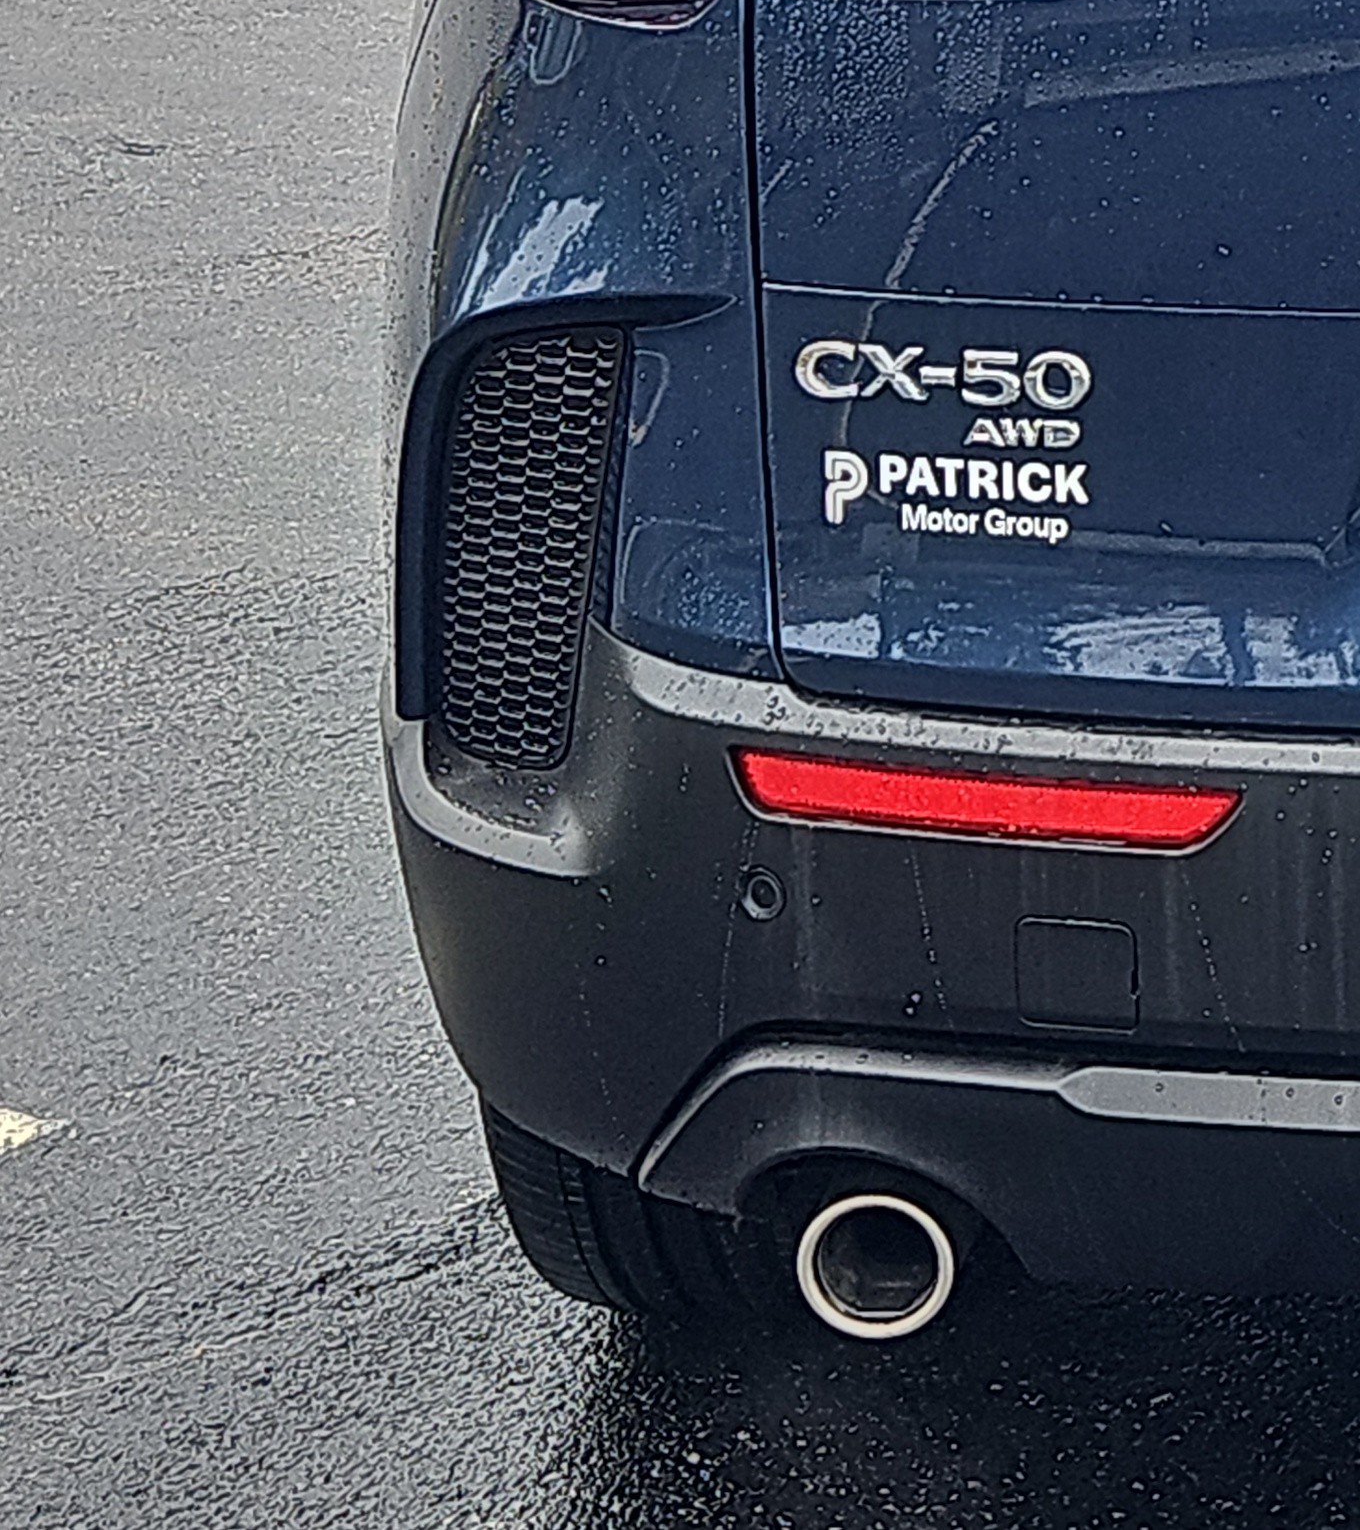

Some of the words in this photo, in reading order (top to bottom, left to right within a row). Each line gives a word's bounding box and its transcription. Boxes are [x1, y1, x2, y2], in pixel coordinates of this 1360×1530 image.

[795, 340, 1092, 410] CX-50
[963, 417, 1081, 448] AWD
[879, 453, 1089, 504] PATRICK
[901, 503, 980, 532] Motor
[984, 508, 1069, 544] Group
